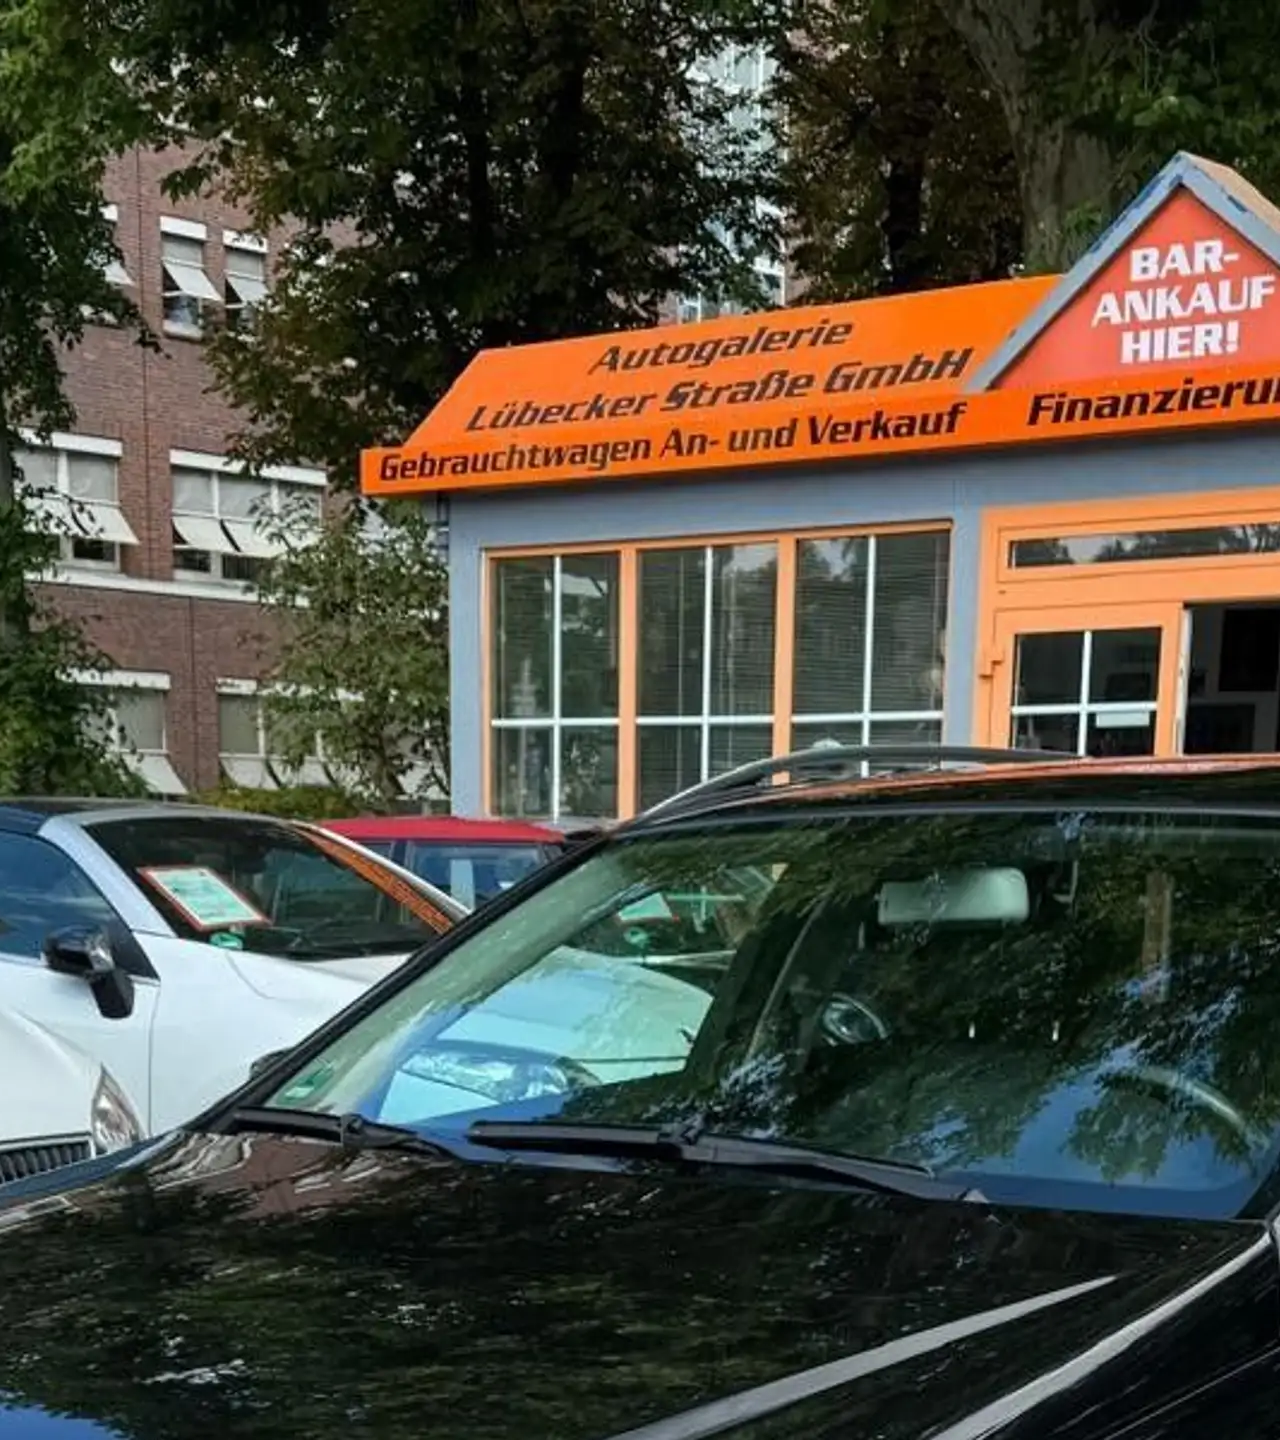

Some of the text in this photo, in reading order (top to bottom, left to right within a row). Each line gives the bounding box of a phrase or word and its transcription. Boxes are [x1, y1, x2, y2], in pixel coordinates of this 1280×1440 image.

[1129, 239, 1241, 283] BAR-
[1091, 273, 1276, 328] ANKAUF
[588, 318, 853, 374] Autogalerie
[1121, 319, 1240, 365] HIER!
[465, 347, 974, 432] Lübecker Straße GmbH
[379, 402, 968, 481] Gebrauchtwagen An- und Verkauf
